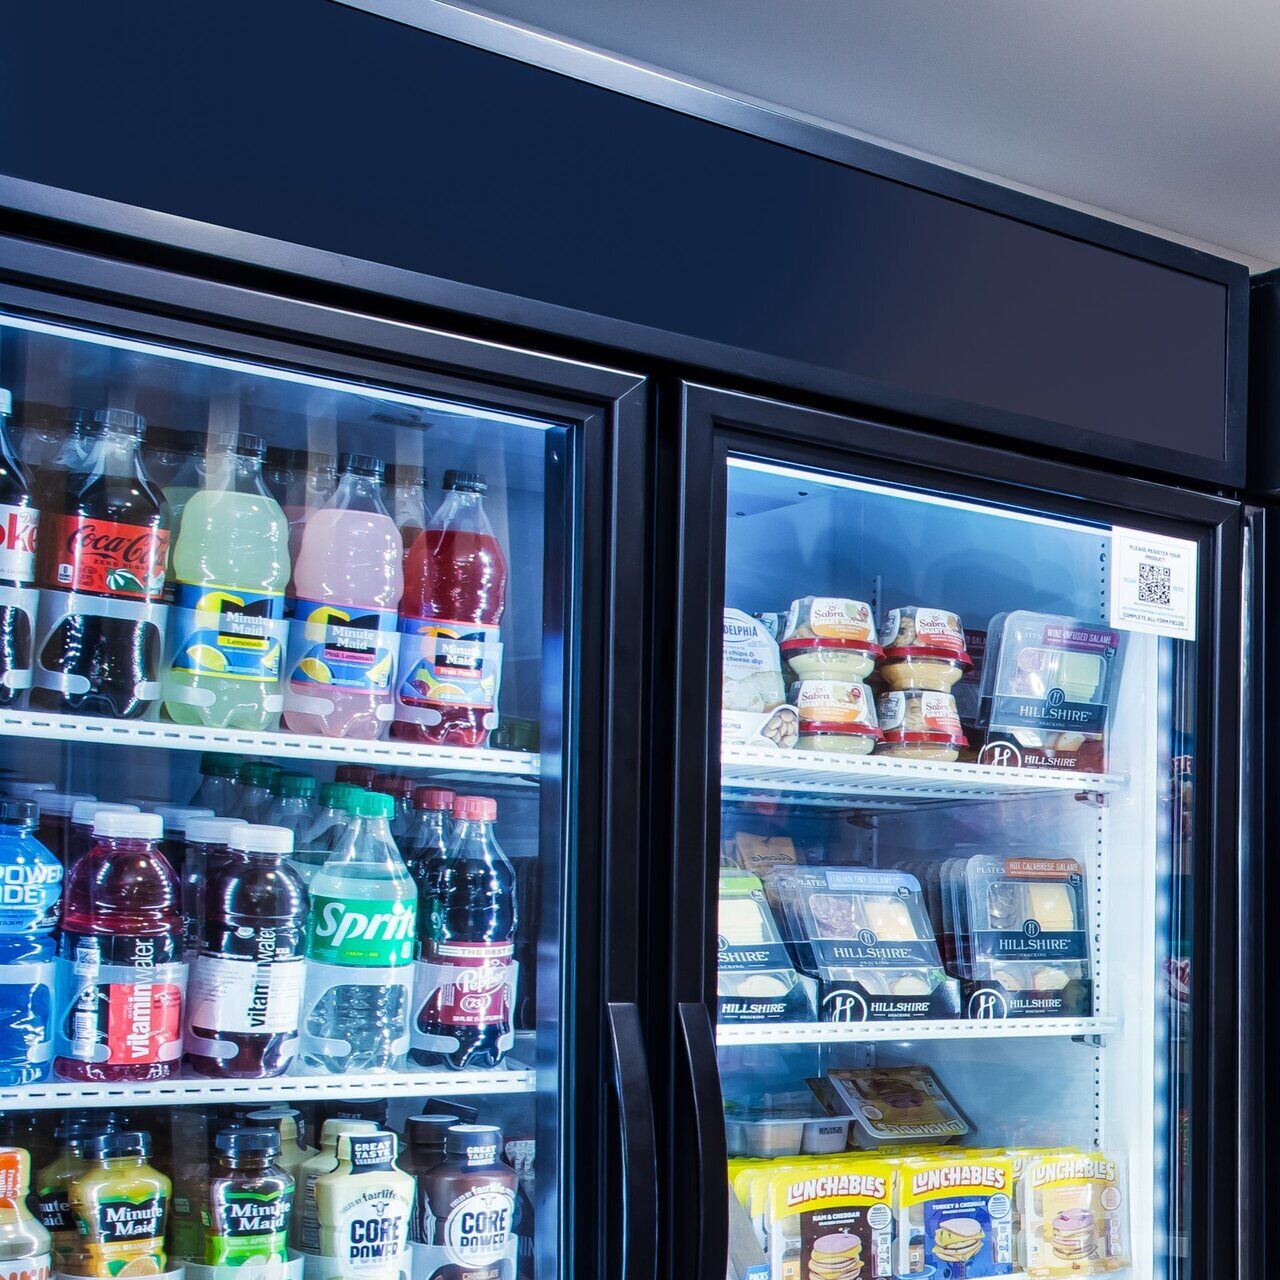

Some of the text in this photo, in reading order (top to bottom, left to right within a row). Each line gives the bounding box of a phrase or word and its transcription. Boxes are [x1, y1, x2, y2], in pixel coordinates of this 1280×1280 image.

[1145, 554, 1166, 563] PRODUCT
[814, 609, 844, 620] Sabra
[1123, 612, 1147, 621] COMPLETE
[920, 618, 946, 629] Sabra
[331, 625, 375, 640] Minute
[801, 691, 830, 702] Sabra
[1020, 705, 1090, 723] HILLSHIRE
[1024, 754, 1076, 768] HILLSHIRE
[1009, 861, 1080, 872] HOT CALABRESE SALAME
[1000, 938, 1070, 951] HILLSHIRE
[834, 946, 912, 960] HILLSHIRE
[126, 938, 154, 1058] vitaminwater
[1010, 998, 1062, 1011] HILLSHIRE
[721, 1002, 787, 1015] HILLSHIRE
[870, 1001, 930, 1014] HILLSHIRE
[354, 1141, 391, 1153] GREAT
[1030, 1157, 1118, 1189] LUNCHABLES
[911, 1166, 1006, 1195] LUNCHABLES
[787, 1175, 887, 1206] LUNCHABLES
[106, 1204, 163, 1224] Minute
[231, 1203, 291, 1220] Minute
[114, 1218, 156, 1237] Maid
[238, 1215, 286, 1231] Maid
[461, 1208, 508, 1236] CORE
[351, 1216, 401, 1244] CORE
